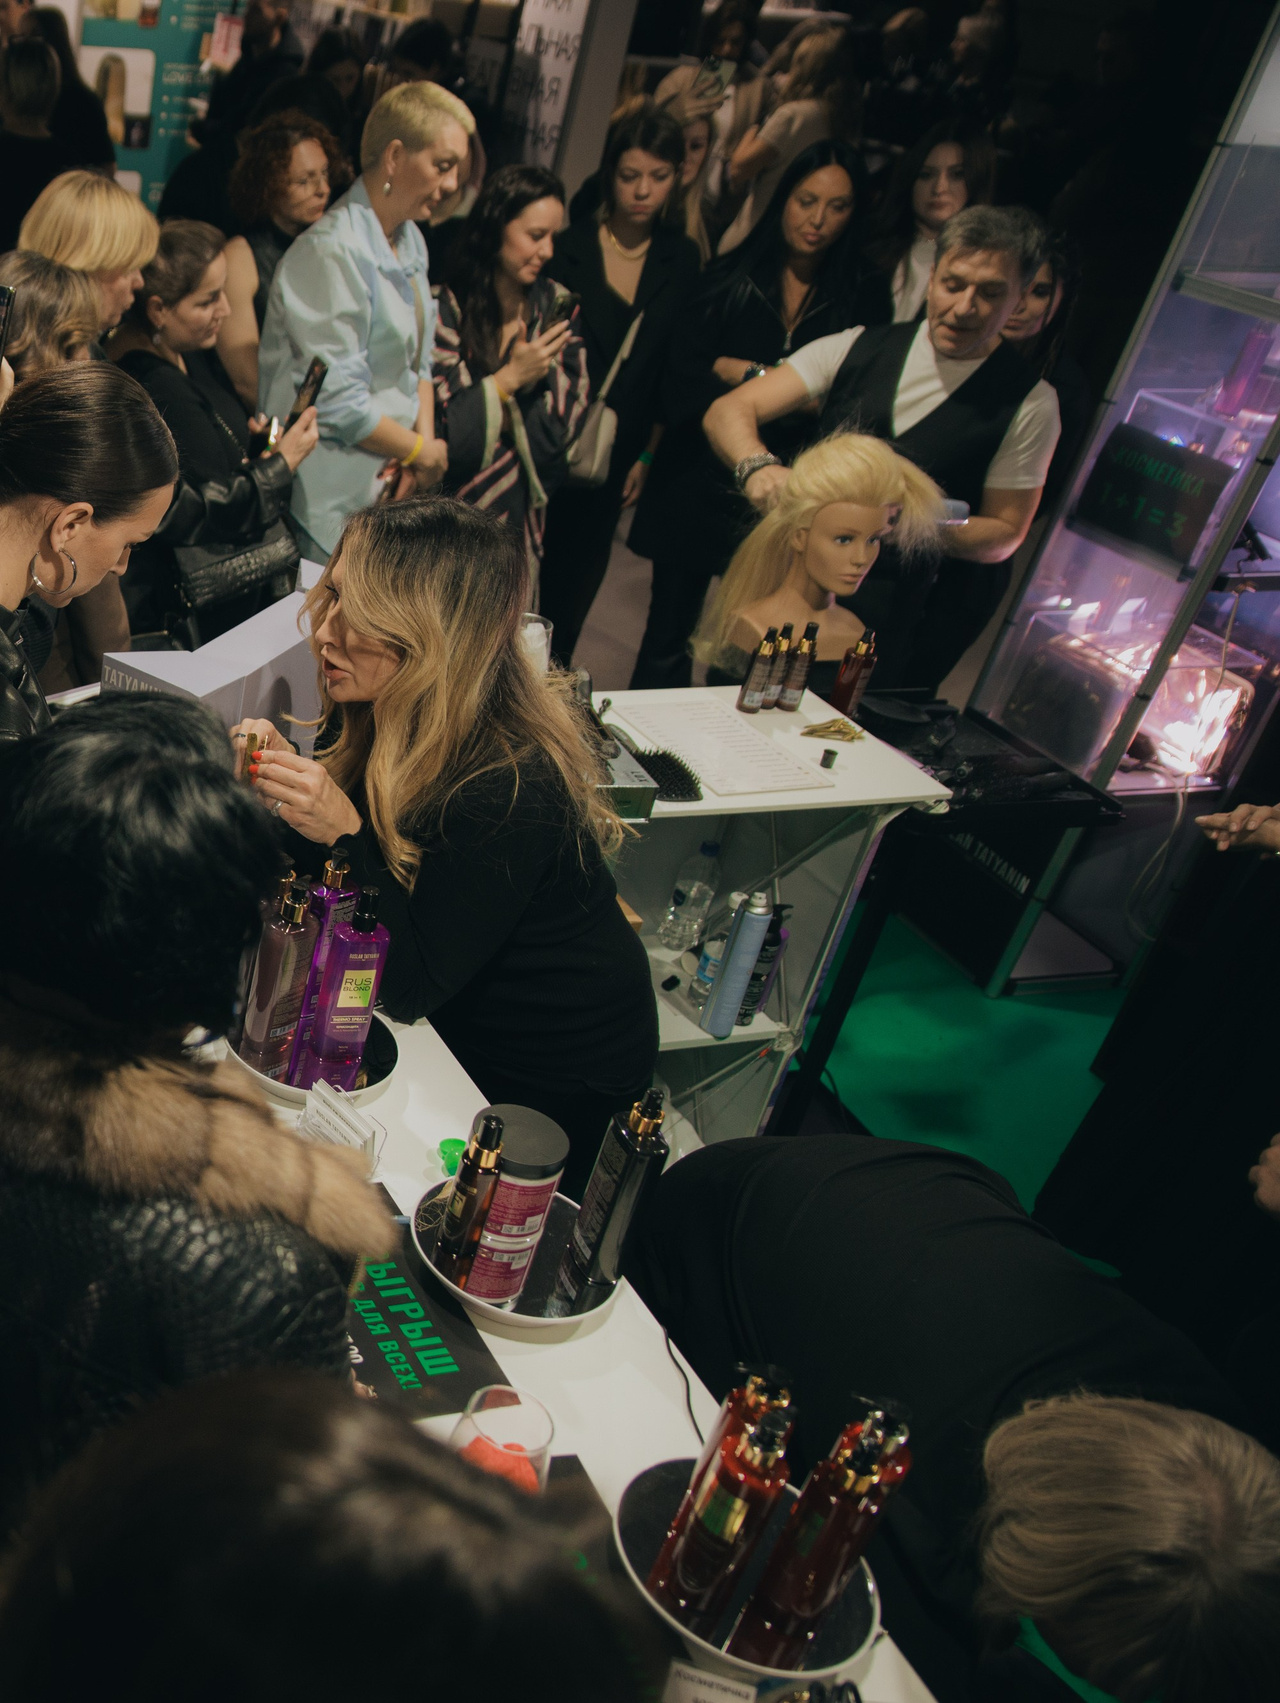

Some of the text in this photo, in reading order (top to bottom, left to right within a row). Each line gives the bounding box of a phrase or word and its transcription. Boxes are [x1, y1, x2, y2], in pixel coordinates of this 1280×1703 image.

[1115, 445, 1206, 498] КОСМЕТИКА
[973, 840, 1031, 895] TATYANIN
[344, 977, 372, 986] RUS
[363, 1254, 460, 1376] ЫГРЫШ
[350, 1299, 423, 1391] ДЛЯ ВСЕХ!
